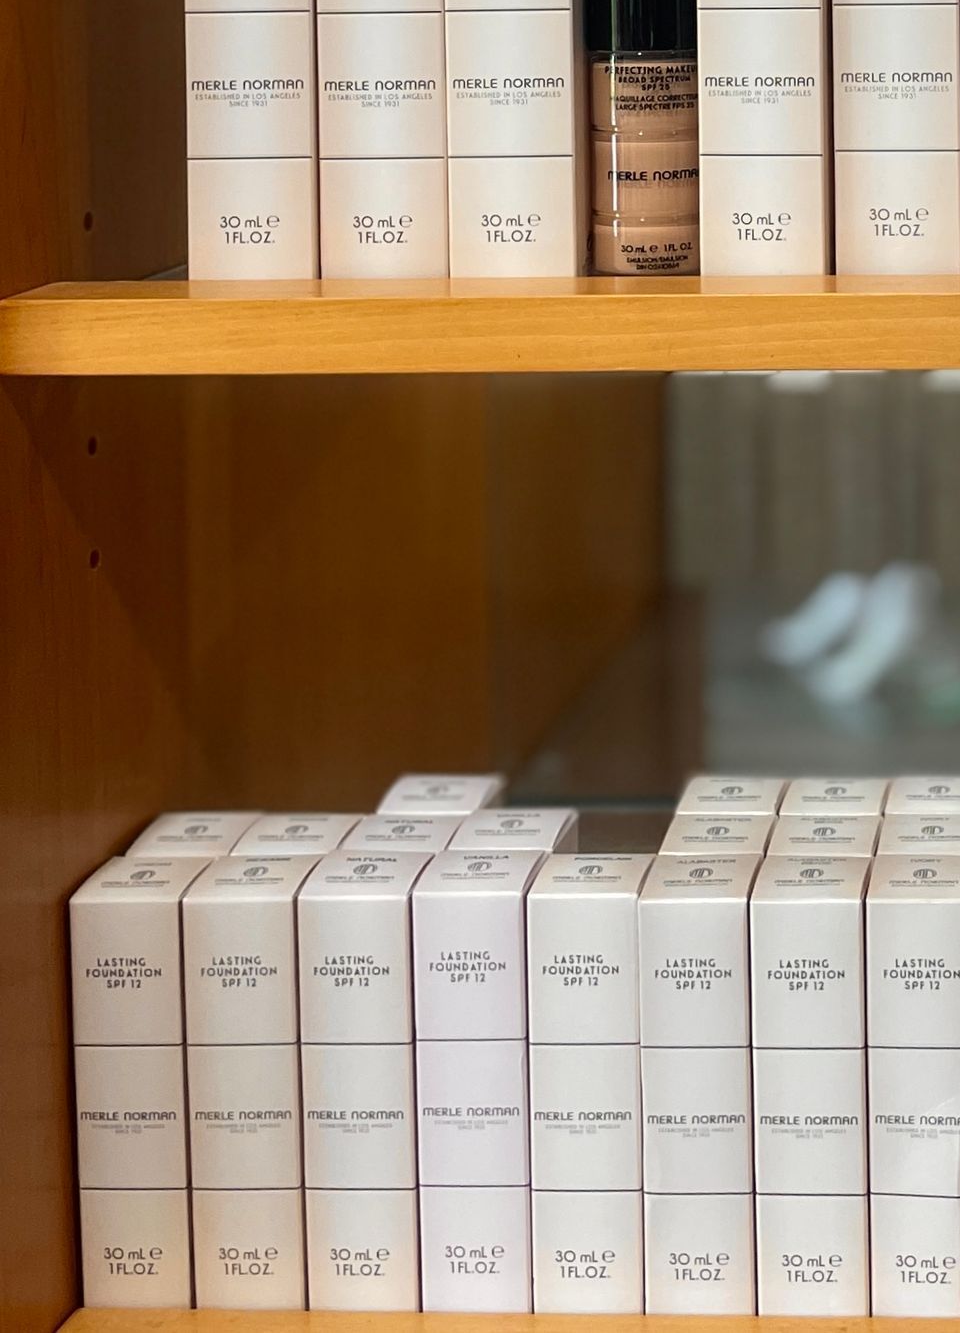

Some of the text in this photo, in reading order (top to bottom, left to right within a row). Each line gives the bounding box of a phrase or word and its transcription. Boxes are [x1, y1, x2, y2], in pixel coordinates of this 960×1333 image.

[191, 79, 304, 91] MERLE NORMAN
[705, 76, 815, 87] MERLE NORMAN
[220, 216, 263, 229] 30 mL
[621, 245, 633, 253] 30
[635, 245, 647, 253] mL
[97, 957, 146, 967] LASTING
[86, 968, 162, 978] FOUNDATION
[107, 979, 141, 989] SPF 12
[80, 1111, 177, 1121] MERLE NORMAN
[104, 1247, 146, 1260] 30 mL
